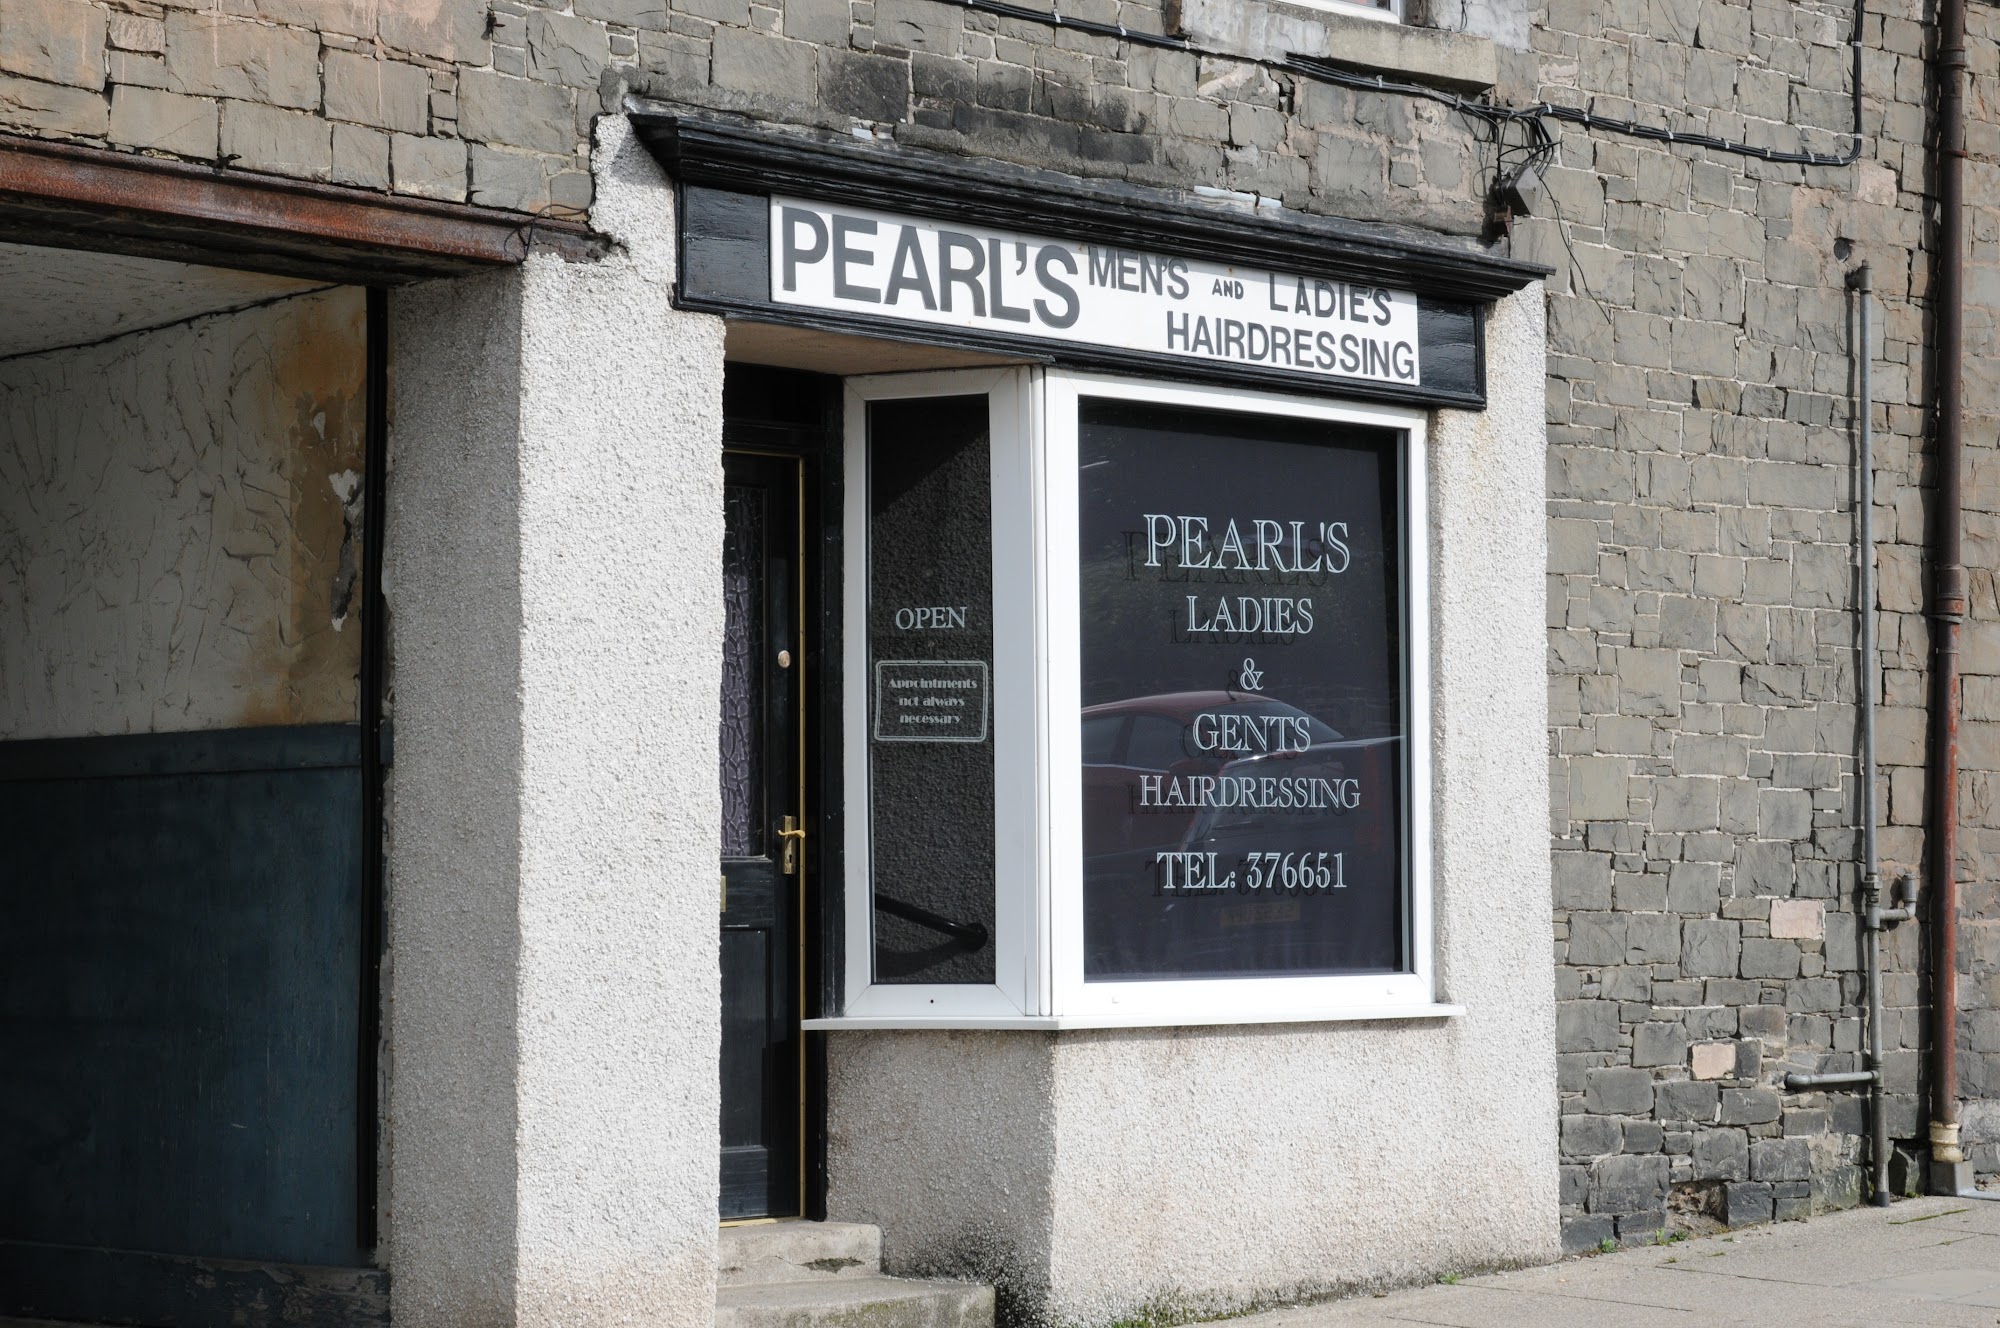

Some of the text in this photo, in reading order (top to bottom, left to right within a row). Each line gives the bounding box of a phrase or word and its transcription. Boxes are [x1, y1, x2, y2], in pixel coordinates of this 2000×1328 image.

[782, 206, 1080, 329] PEARL'S
[1087, 246, 1392, 327] MEN'S AND LADIE'S
[1166, 311, 1415, 380] HAIRDRESSING
[1143, 513, 1350, 573] PEARL'S
[895, 606, 968, 630] OPEN
[1186, 595, 1314, 634] LADIES
[887, 678, 978, 689] Appointments
[1239, 657, 1264, 690] &
[898, 696, 965, 707] not always
[899, 714, 963, 724] necessary
[1192, 713, 1311, 752] GENTS
[1139, 774, 1361, 809] HAIRDRESSING
[1156, 852, 1347, 889] TEL: 376651
